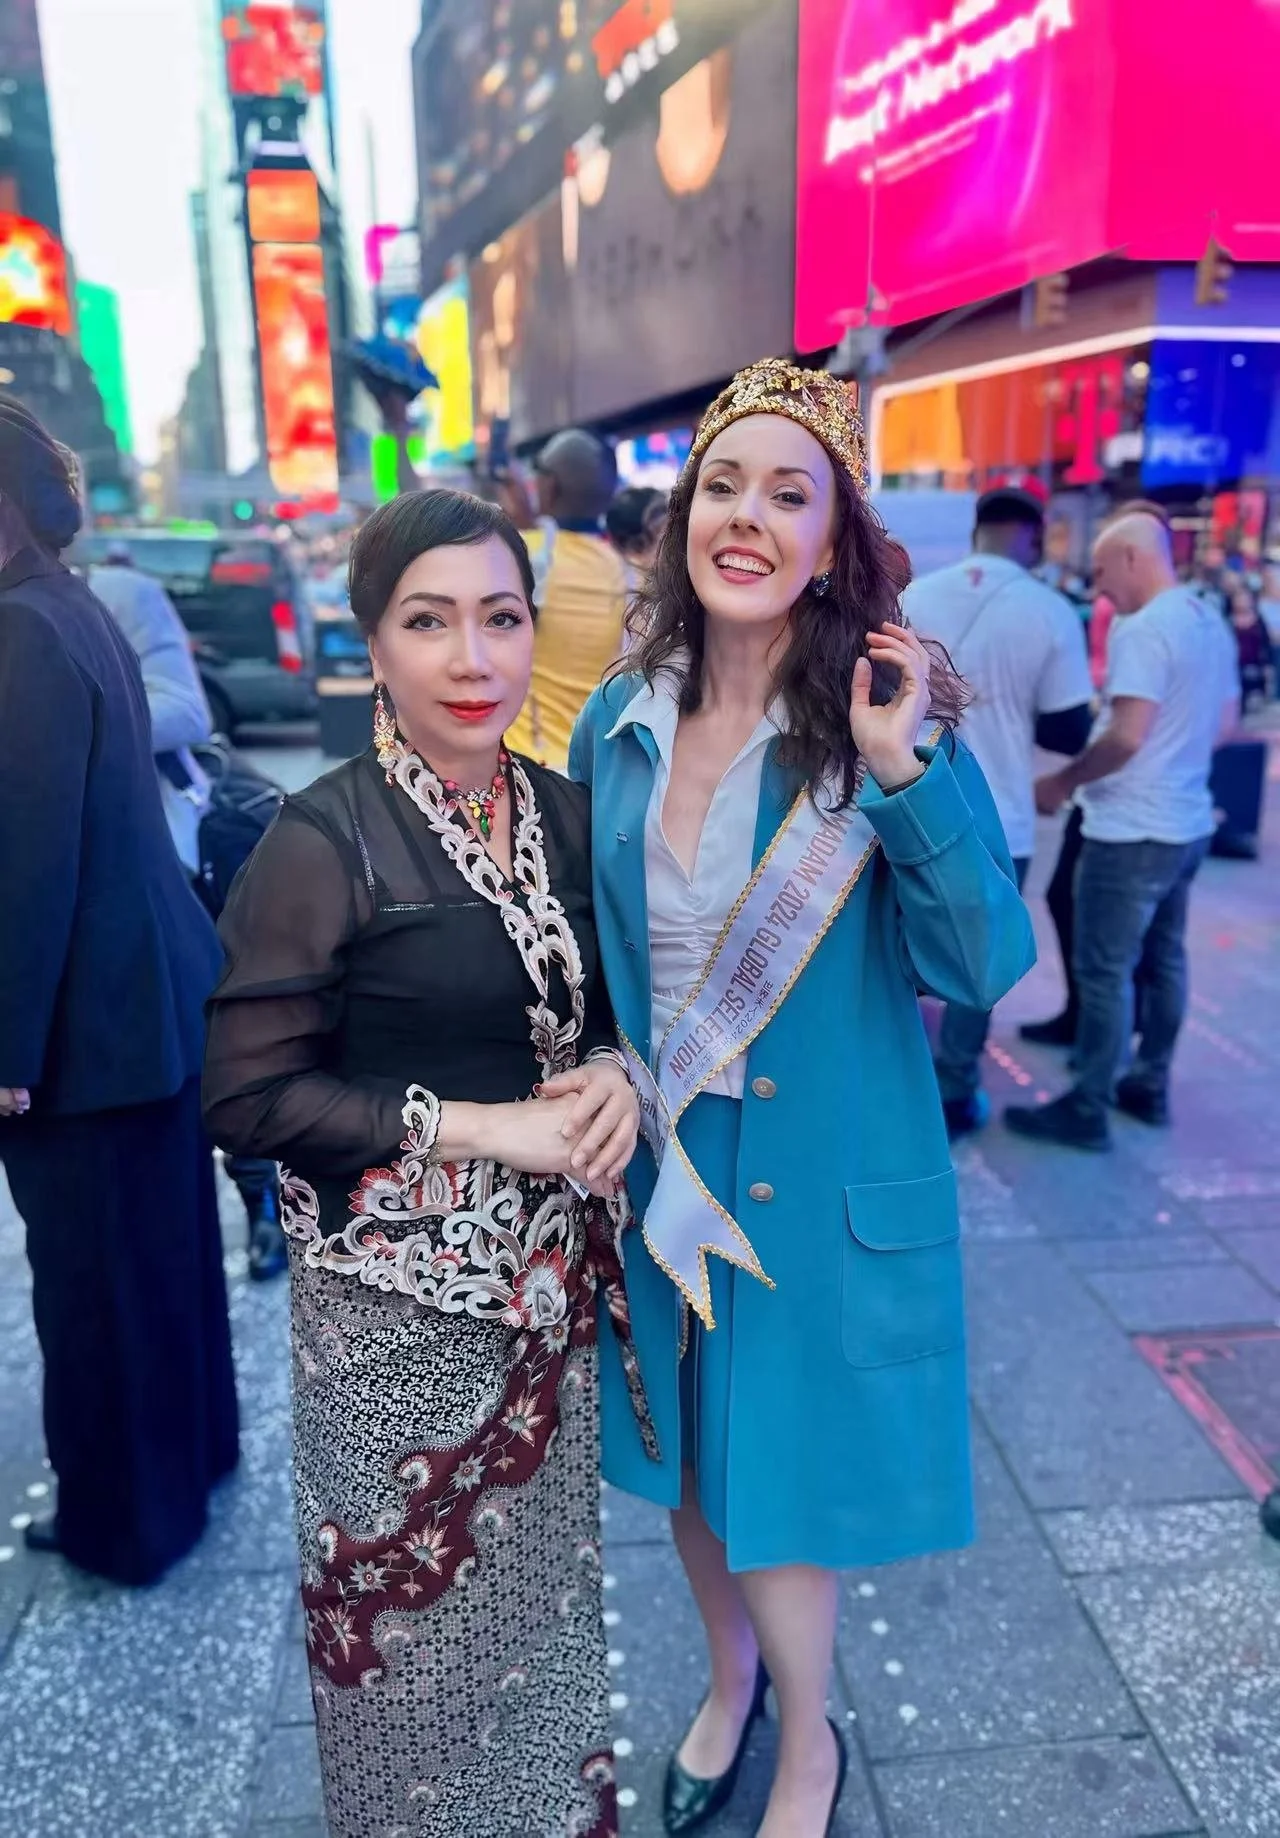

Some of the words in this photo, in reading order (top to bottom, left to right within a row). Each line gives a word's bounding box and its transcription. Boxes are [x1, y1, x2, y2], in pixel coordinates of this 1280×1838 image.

[797, 813, 854, 887] MADAM
[769, 878, 810, 932] 2024
[731, 930, 782, 994] GLOBAL
[668, 988, 746, 1081] SELECTION
